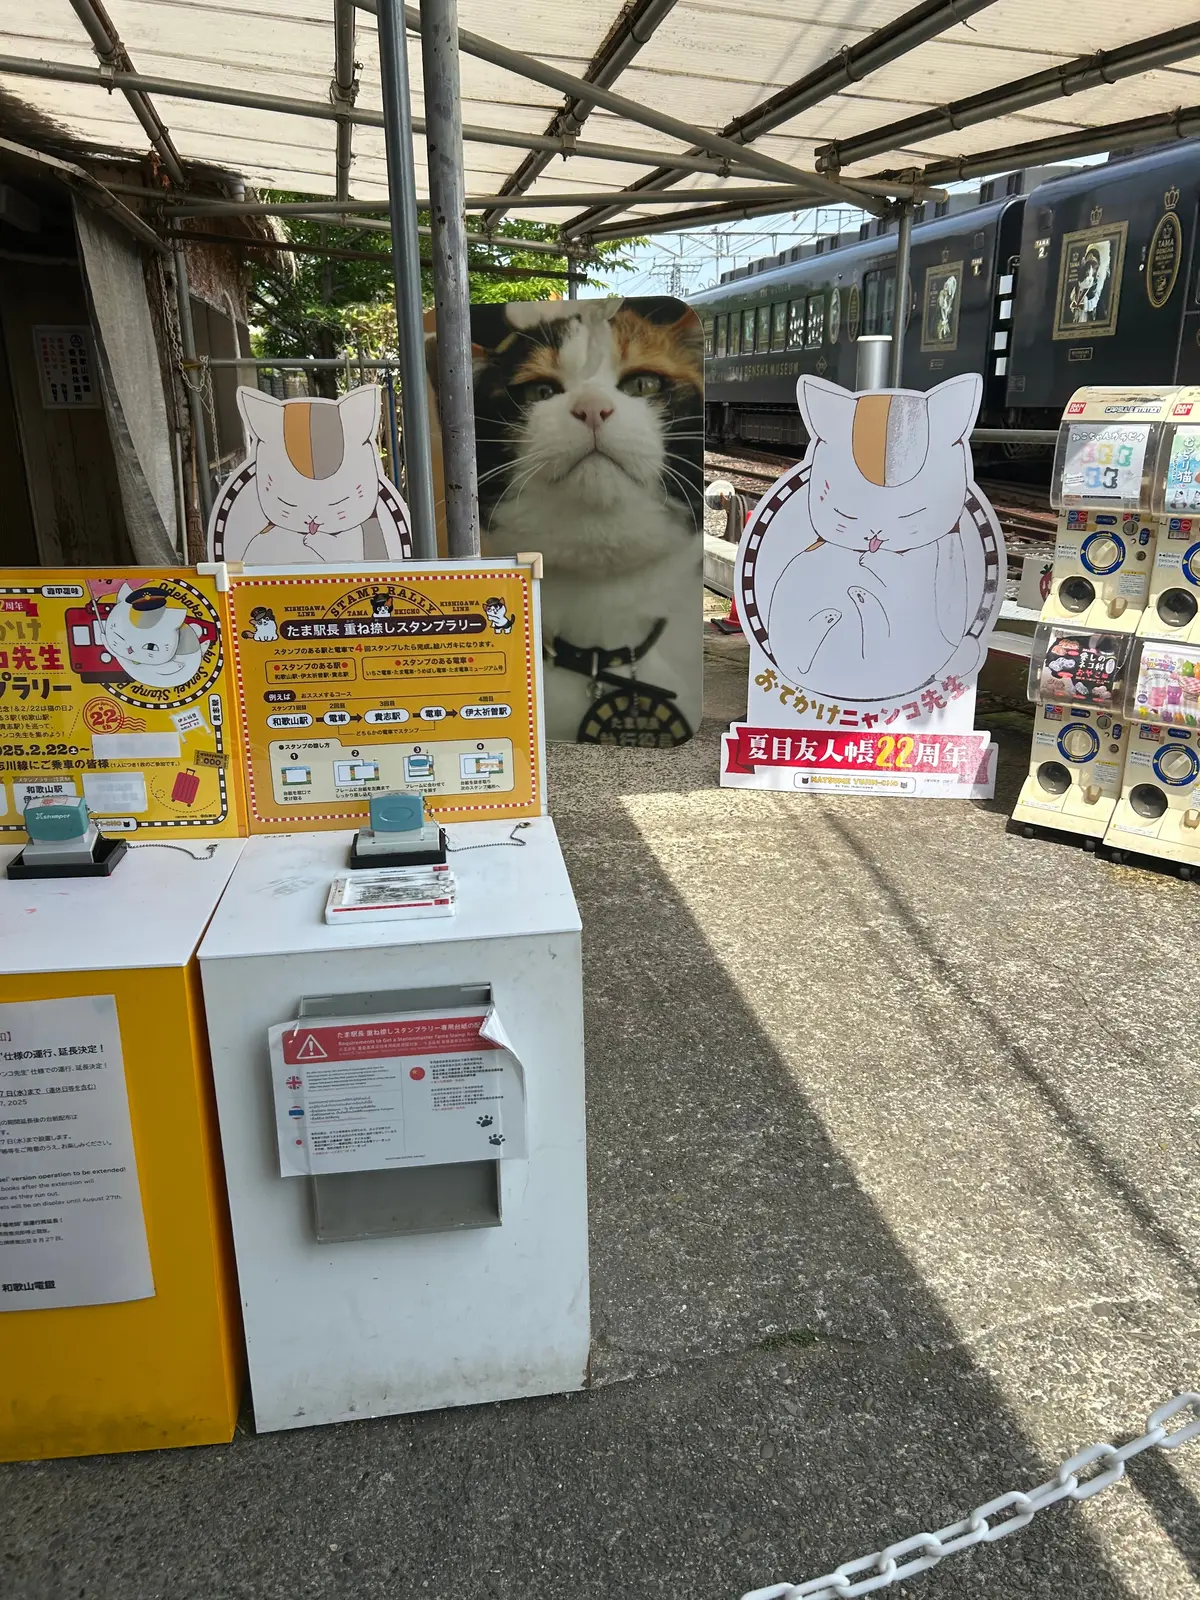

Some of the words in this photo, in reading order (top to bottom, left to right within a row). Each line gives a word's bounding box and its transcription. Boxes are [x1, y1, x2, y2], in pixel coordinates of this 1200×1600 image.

[1158, 239, 1174, 247] TAMA
[744, 364, 769, 377] DENSHA
[770, 362, 800, 375] MUSEUM
[1177, 436, 1195, 483] むっちり猫
[159, 582, 205, 620] Odekake
[330, 586, 380, 617] STAMP
[386, 586, 437, 614] RALLY
[287, 623, 340, 637] たま駅長
[281, 661, 341, 671] スタンプのある駅
[402, 656, 467, 667] スタンプのある電車
[172, 665, 209, 698] Sensei
[131, 682, 171, 702] Stamp
[268, 693, 291, 701] 例えば
[754, 667, 971, 729] おでかけニャンコ先生
[89, 708, 118, 726] 22
[328, 714, 347, 722] 電車
[374, 711, 401, 721] 貴志駅
[425, 709, 443, 717] 電車
[464, 707, 508, 717] 伊太祈曽駅
[272, 716, 309, 726] 和歌山駅
[356, 728, 419, 737] どちらかの電車でスタンプ
[747, 733, 968, 769] 夏目友人帳22周年
[810, 776, 852, 786] NATSUME
[26, 785, 63, 794] 和歌山駅
[11, 1175, 37, 1183] version
[38, 1171, 72, 1181] operation
[1, 1184, 20, 1192] books
[51, 1179, 82, 1188] extension
[42, 1200, 65, 1208] display
[82, 1196, 104, 1204] August
